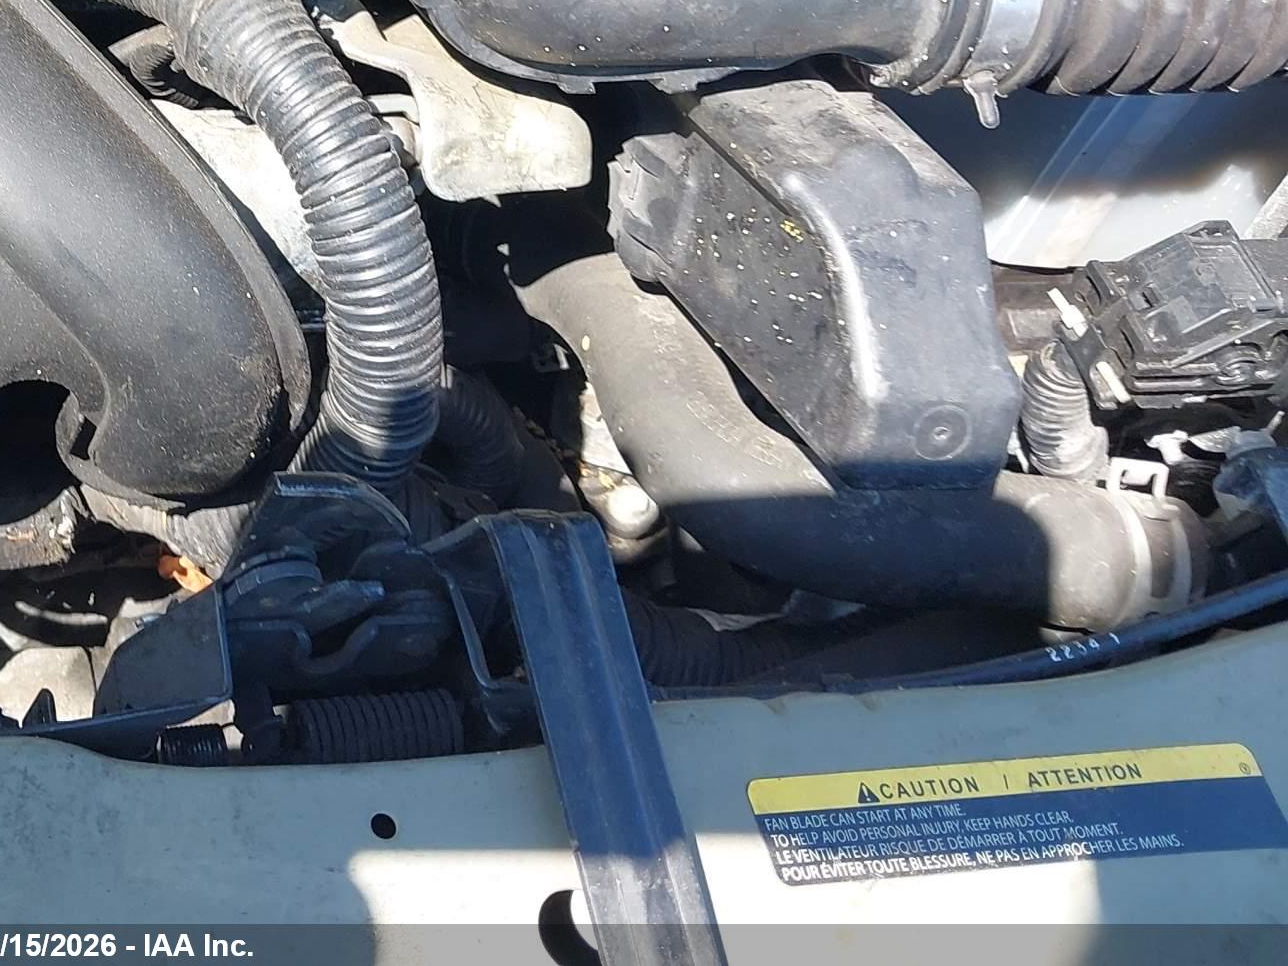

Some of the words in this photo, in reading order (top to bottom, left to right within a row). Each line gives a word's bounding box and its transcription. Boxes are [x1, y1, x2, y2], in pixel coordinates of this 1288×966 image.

[878, 775, 979, 800] CAUTION
[1026, 762, 1142, 788] ATTENTION
[764, 817, 788, 831] FAN
[789, 813, 828, 829] BLADE
[829, 811, 855, 826] CAN
[856, 808, 891, 824] START
[893, 807, 907, 820] AT
[909, 805, 933, 819] ANY
[933, 802, 966, 818] TIME.
[770, 833, 789, 847] TO
[790, 831, 819, 846] HELP
[821, 828, 858, 843] AVOID
[859, 822, 921, 840] PERSONAL
[964, 817, 991, 831] KEEP
[992, 813, 1033, 829] HANDS
[1034, 809, 1074, 825] CLEAR.
[775, 850, 793, 864] LE
[793, 843, 878, 863] VENTILATEUR
[879, 839, 926, 857] RISQUE
[927, 838, 945, 851] DE
[946, 831, 1014, 849] DÉMARRER
[1017, 829, 1028, 844] À
[1028, 827, 1061, 843] TOUT
[1063, 822, 1123, 840] MOMENT.
[781, 864, 820, 882] POUR
[819, 859, 865, 879] ÉVITER
[865, 857, 907, 874] TOUTE
[909, 851, 976, 871] BLESSURE,
[975, 850, 996, 863] NE
[995, 848, 1019, 861] PAS
[1021, 846, 1039, 859] EN
[1040, 839, 1113, 857] APPROCHER
[1115, 837, 1137, 850] LES
[1138, 833, 1184, 849] MAINS.
